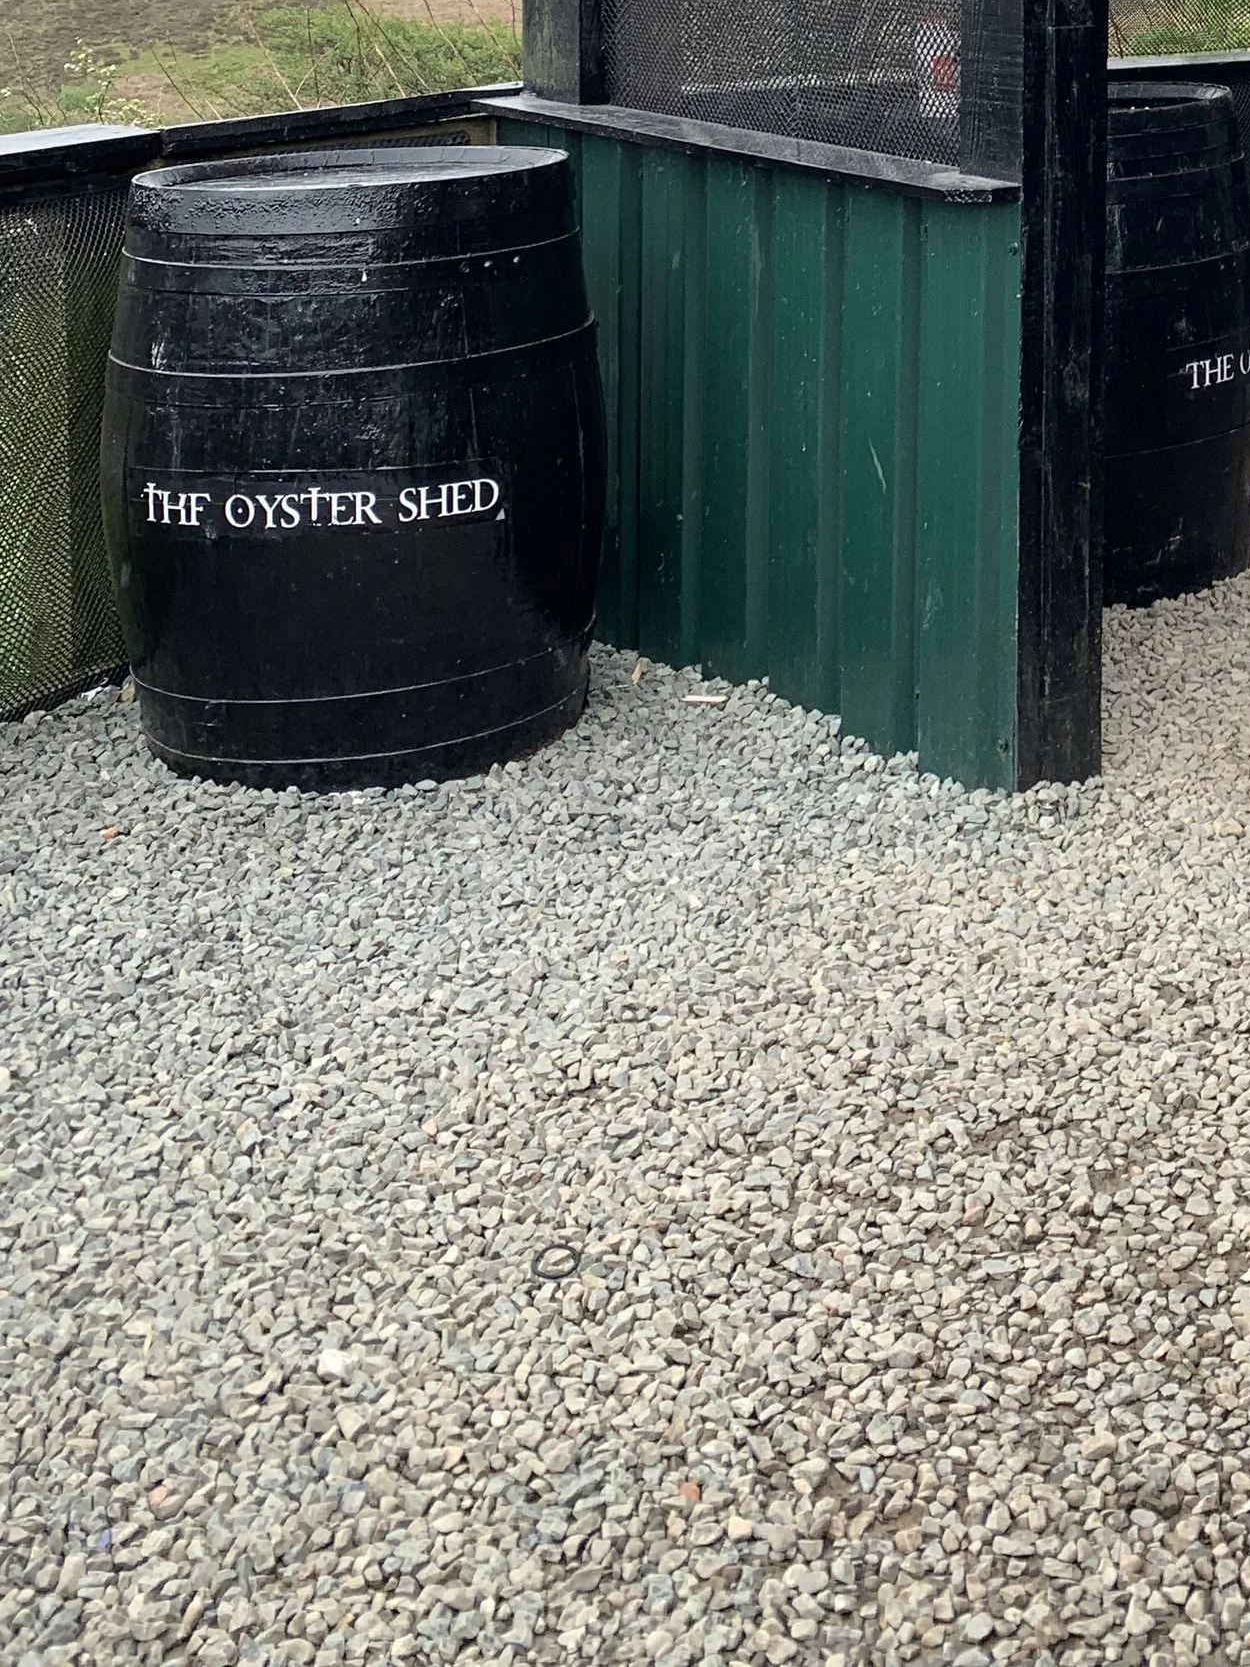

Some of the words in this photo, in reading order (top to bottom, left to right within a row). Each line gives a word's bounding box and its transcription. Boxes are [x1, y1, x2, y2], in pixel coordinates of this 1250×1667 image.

[1187, 354, 1235, 390] THE
[225, 487, 382, 529] OYSTER
[399, 479, 499, 522] SHED
